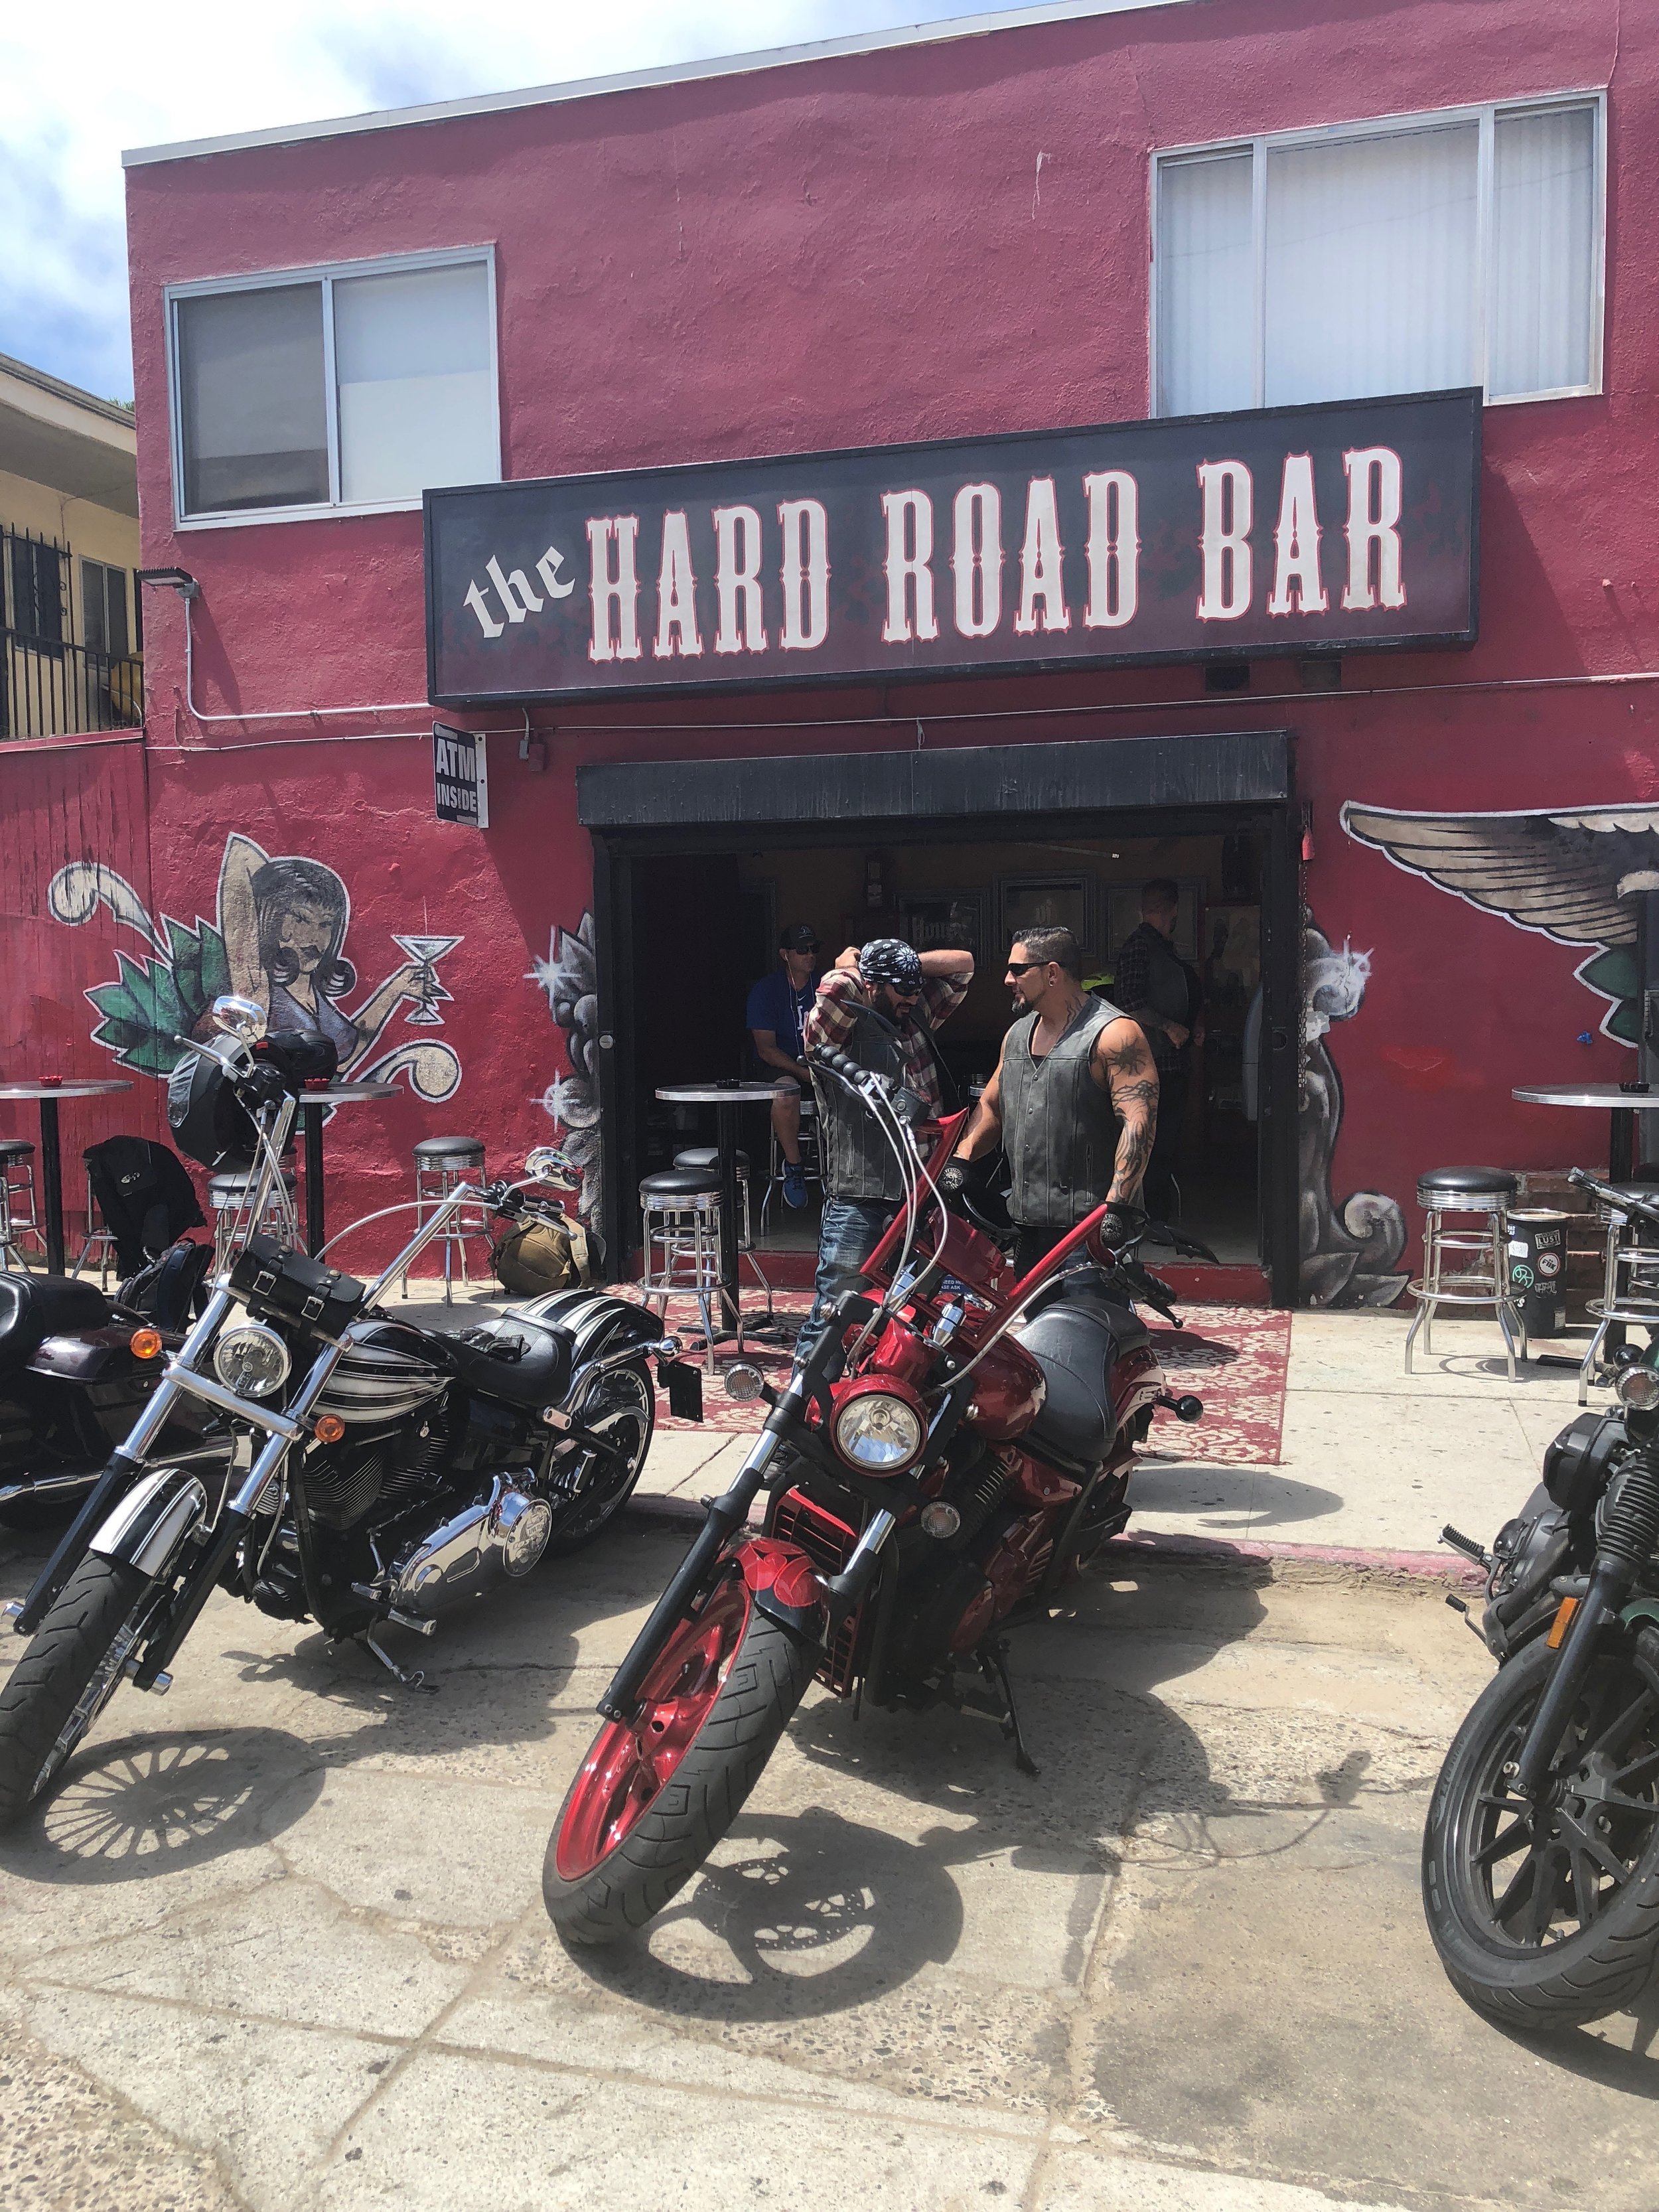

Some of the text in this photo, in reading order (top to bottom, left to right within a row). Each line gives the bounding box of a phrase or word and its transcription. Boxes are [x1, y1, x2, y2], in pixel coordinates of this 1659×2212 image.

[463, 445, 1408, 664] the HARD ROAD BAR
[435, 737, 476, 783] ATM
[437, 782, 477, 812] INSIDE
[1538, 1235, 1559, 1245] LUST
